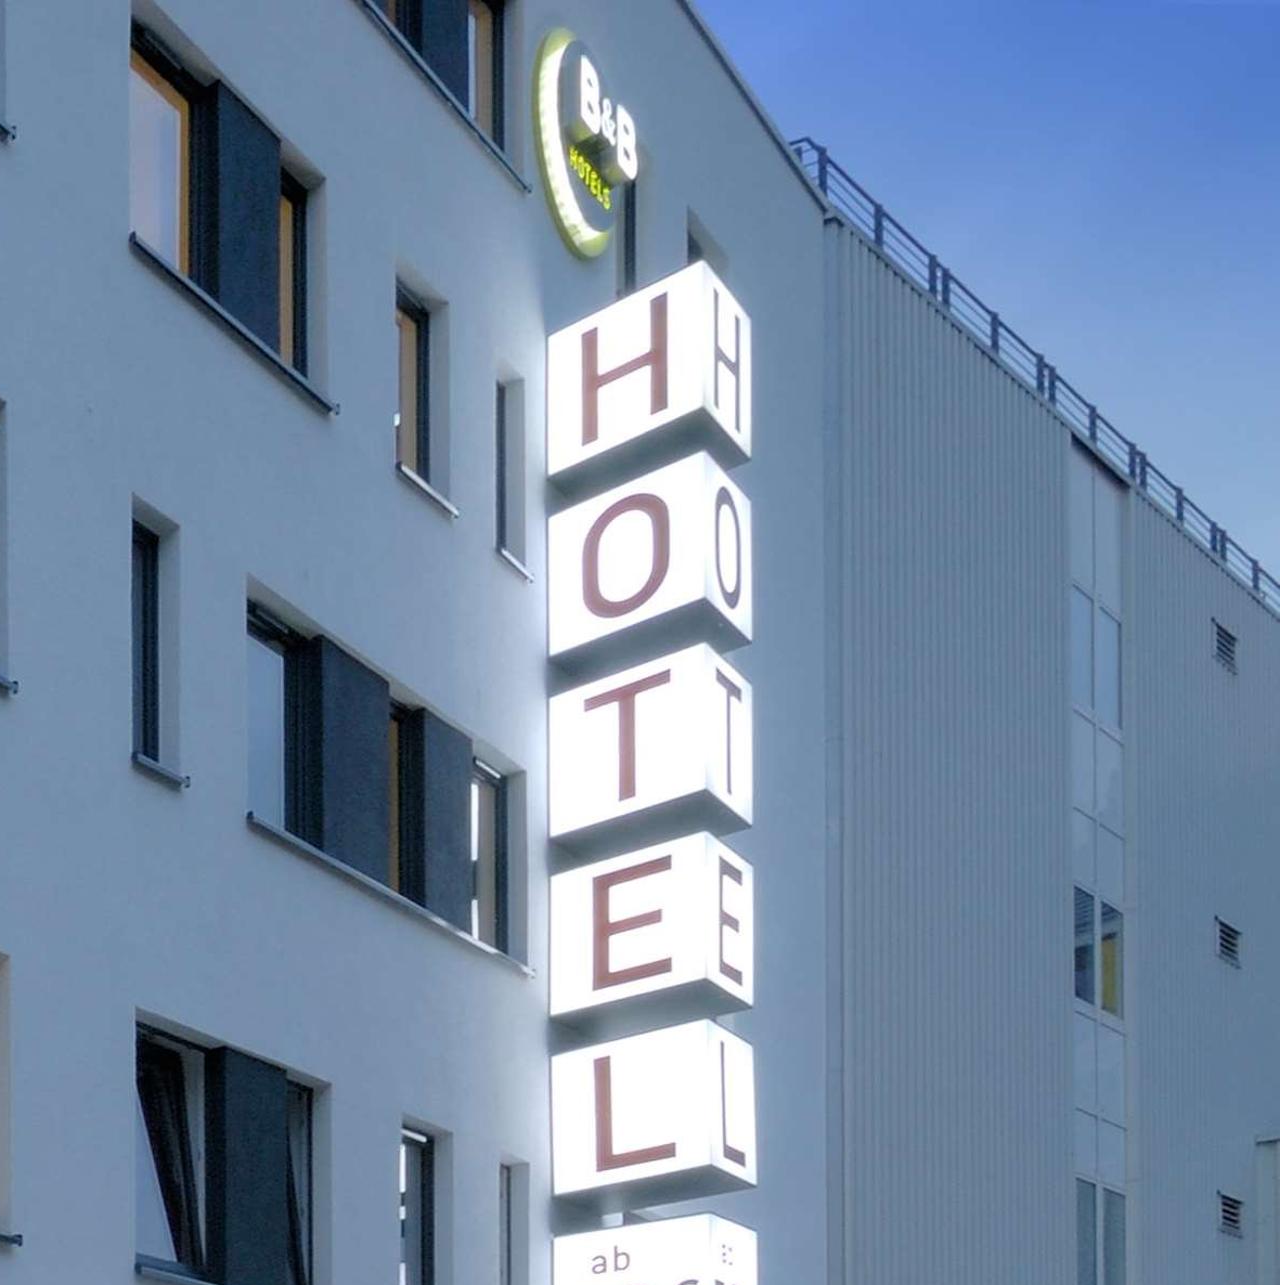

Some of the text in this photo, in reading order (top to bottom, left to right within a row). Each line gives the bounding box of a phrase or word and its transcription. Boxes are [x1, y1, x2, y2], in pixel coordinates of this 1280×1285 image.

[569, 145, 612, 211] HOTELS
[580, 54, 638, 180] B&B
[581, 291, 677, 1172] HOTEL
[713, 286, 746, 1169] HOTEL
[591, 1245, 631, 1275] ab
